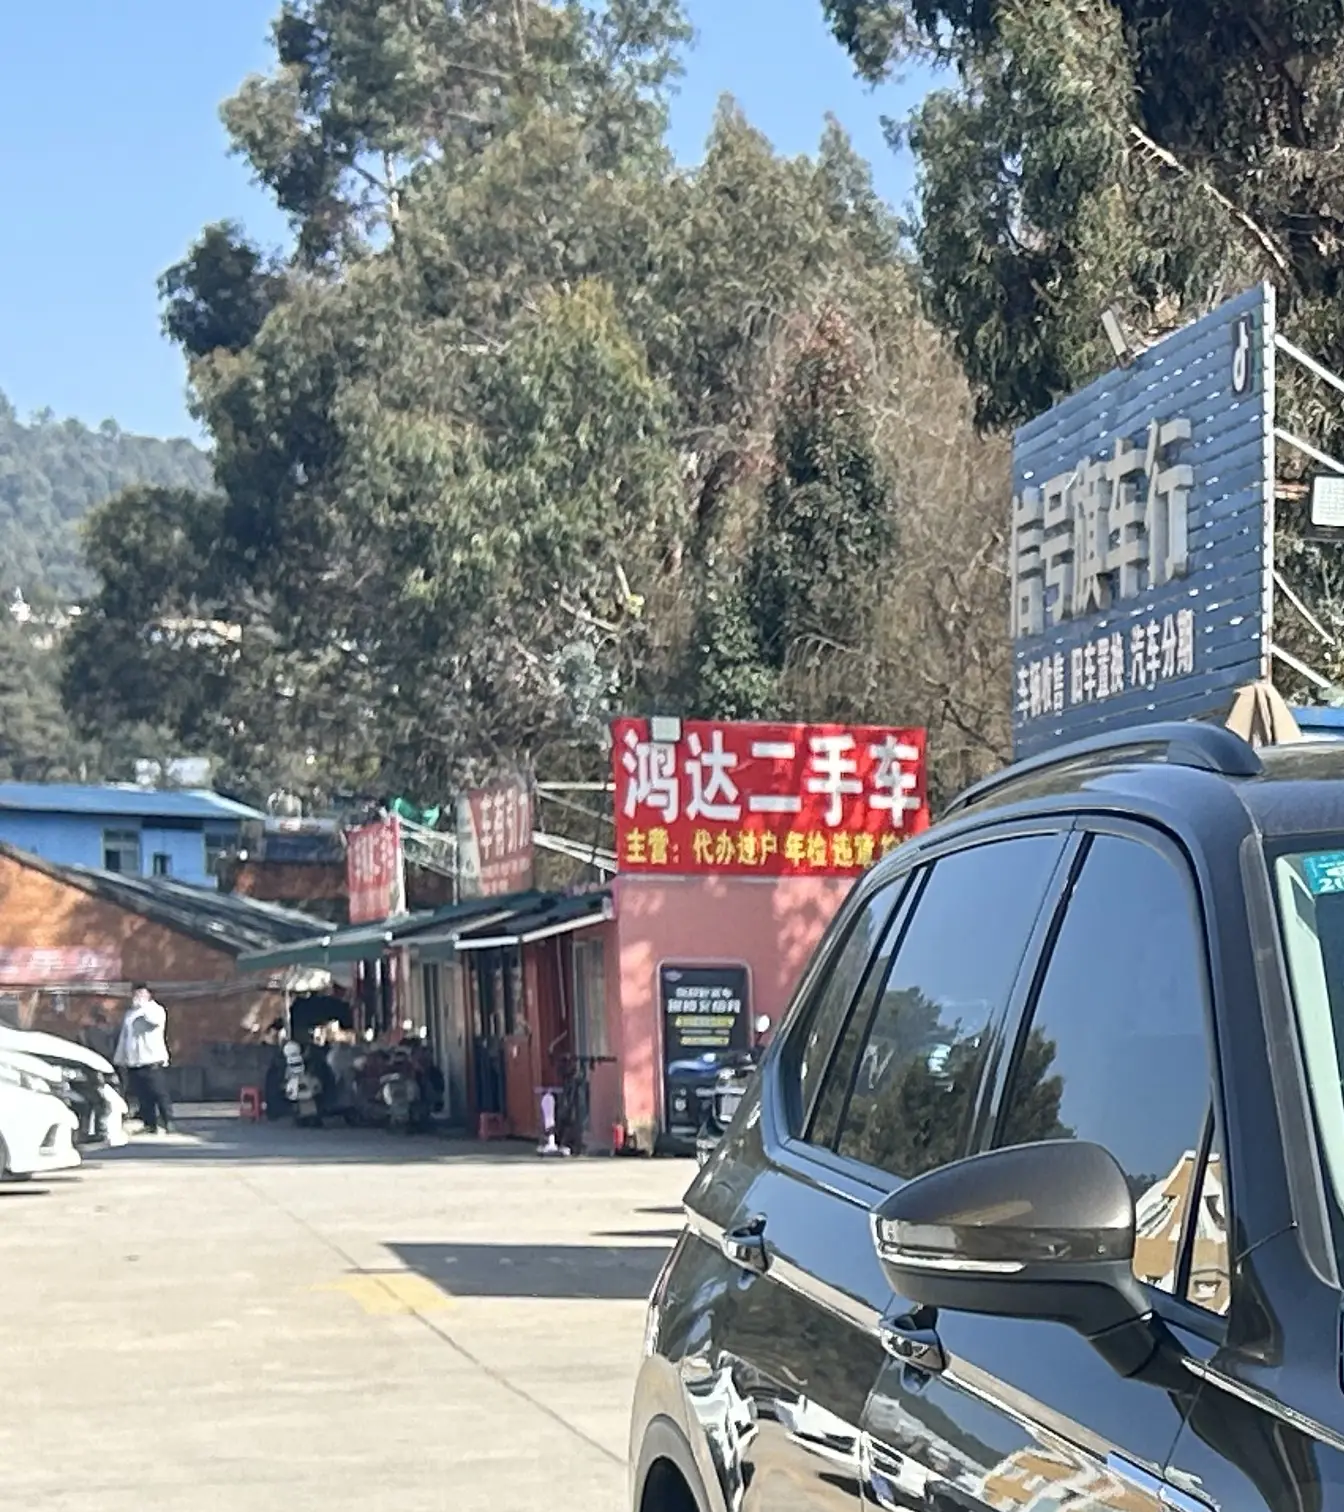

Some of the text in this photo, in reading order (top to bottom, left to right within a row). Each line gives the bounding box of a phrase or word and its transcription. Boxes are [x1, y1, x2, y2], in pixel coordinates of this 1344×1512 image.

[622, 728, 921, 827] 鸿达二手车
[693, 828, 777, 866] 代办过户
